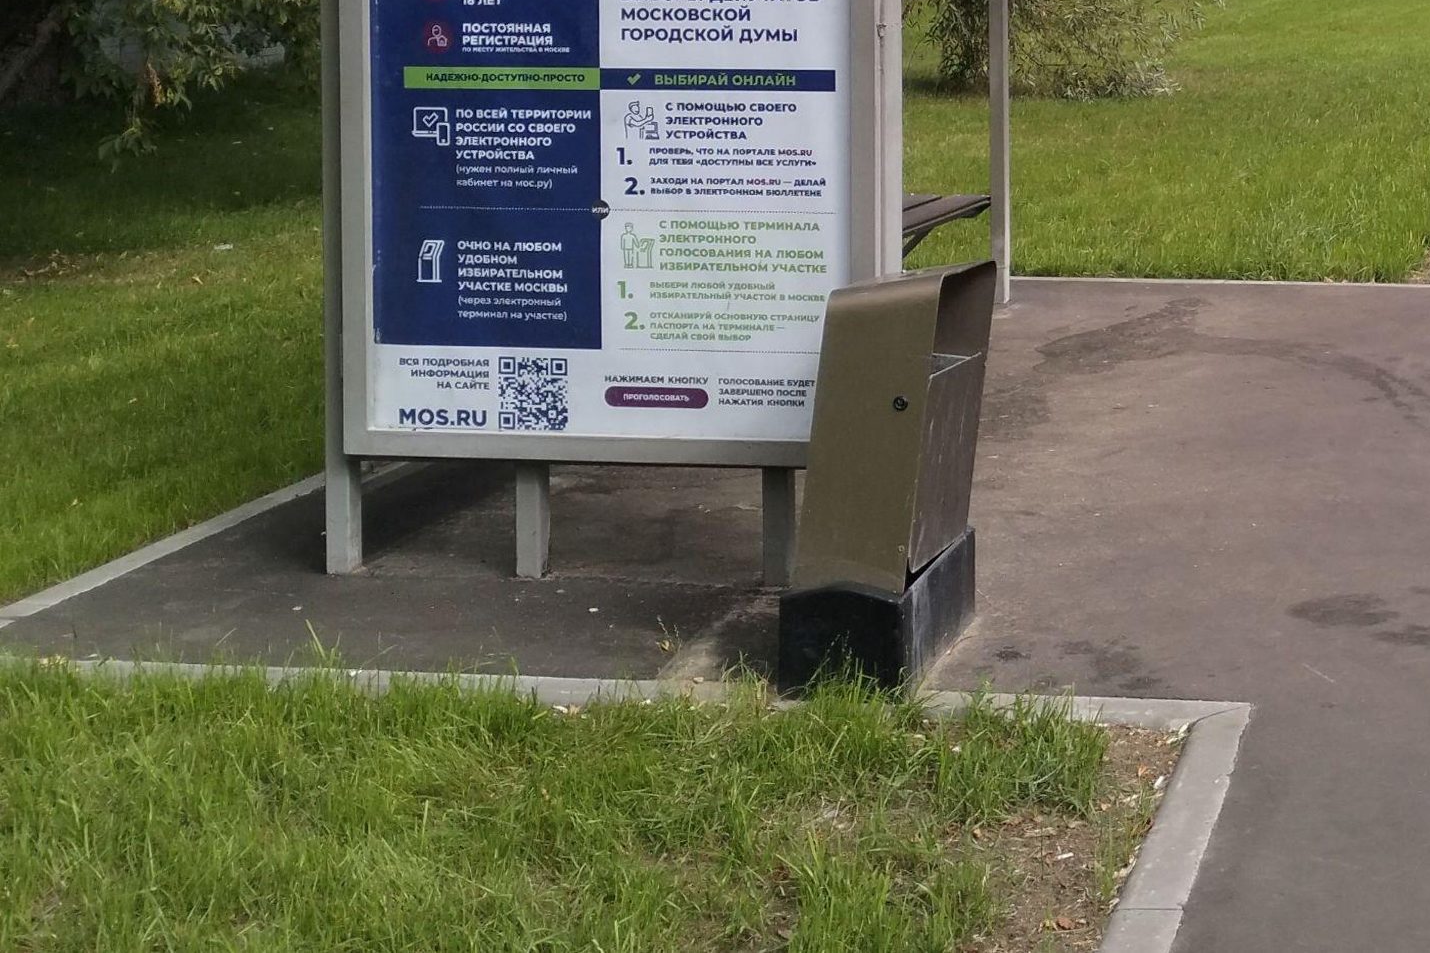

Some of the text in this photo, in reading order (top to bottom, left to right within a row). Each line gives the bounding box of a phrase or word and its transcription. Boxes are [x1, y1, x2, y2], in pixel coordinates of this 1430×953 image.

[621, 6, 750, 21] МОСКОВСКОЙ
[463, 23, 551, 33] ПОСТОЯННАЯ
[621, 25, 797, 44] ГОРОДСКОЙ ДУМЫ
[463, 36, 552, 47] РЕГИСТРАЦИЯ
[655, 73, 796, 86] ВЫБИРАЙ ОНЛАЙН
[456, 107, 591, 119] ПО ВСЕЙ ТЕРРИТОРИИ
[665, 102, 797, 113] С ПОМОЩЬЮ СВОЕГО
[665, 116, 763, 126] ЭЛЕКТРОННОГО
[455, 123, 575, 133] РОССИИ СО СВОЕГО
[665, 128, 747, 140] УСТРОЙСТВА
[455, 136, 552, 146] ЭЛЕКТРОННОГО
[455, 147, 534, 160] УСТРОЙСТВА
[616, 147, 633, 165] 1.
[733, 148, 775, 156] ПОРТАЛЕ
[649, 158, 668, 166] ДЛЯ
[456, 178, 498, 187] кабинет
[624, 177, 645, 195] 2.
[650, 177, 688, 186] ЗАХОДИ
[794, 177, 826, 187] ДЕЛАЙ
[694, 188, 763, 196] ЭЛЕКТРОННОМ
[766, 189, 821, 197] БЮЛЛЕТЕНЕ
[659, 220, 820, 231] С ПОМОЩЬЮ ТЕРМИНАЛА
[659, 234, 756, 244] ЭЛЕКТРОННОГО
[457, 241, 562, 251] ОЧНО НА ЛЮБОМ
[660, 248, 823, 259] ГОЛОСОВАНИЯ НА ЛЮБОМ
[458, 254, 517, 265] УДОБНОМ
[660, 262, 827, 273] ИЗБИРАТЕЛЬНОМ УЧАСТКЕ
[458, 268, 563, 279] ИЗБИРАТЕЛЬНОМ
[458, 281, 567, 292] УЧАСТКЕ МОСКВЫ
[617, 281, 633, 299] 1.
[458, 296, 561, 307] (через электронный
[458, 310, 507, 320] терминал
[525, 311, 567, 321] участке)
[624, 311, 645, 330] 2.
[422, 359, 489, 367] ПОДРОБНАЯ
[411, 370, 489, 379] ИНФОРМАЦИЯ
[605, 375, 708, 385] НАЖИМАЕМ КНОПКУ
[455, 380, 489, 390] САЙТЕ
[718, 378, 815, 388] ГОЛОСОВАНИЕ БУДЕТ
[776, 389, 807, 397] ПОСЛЕ
[767, 399, 805, 407] КНОПКИ
[399, 408, 487, 426] MOS.RU
